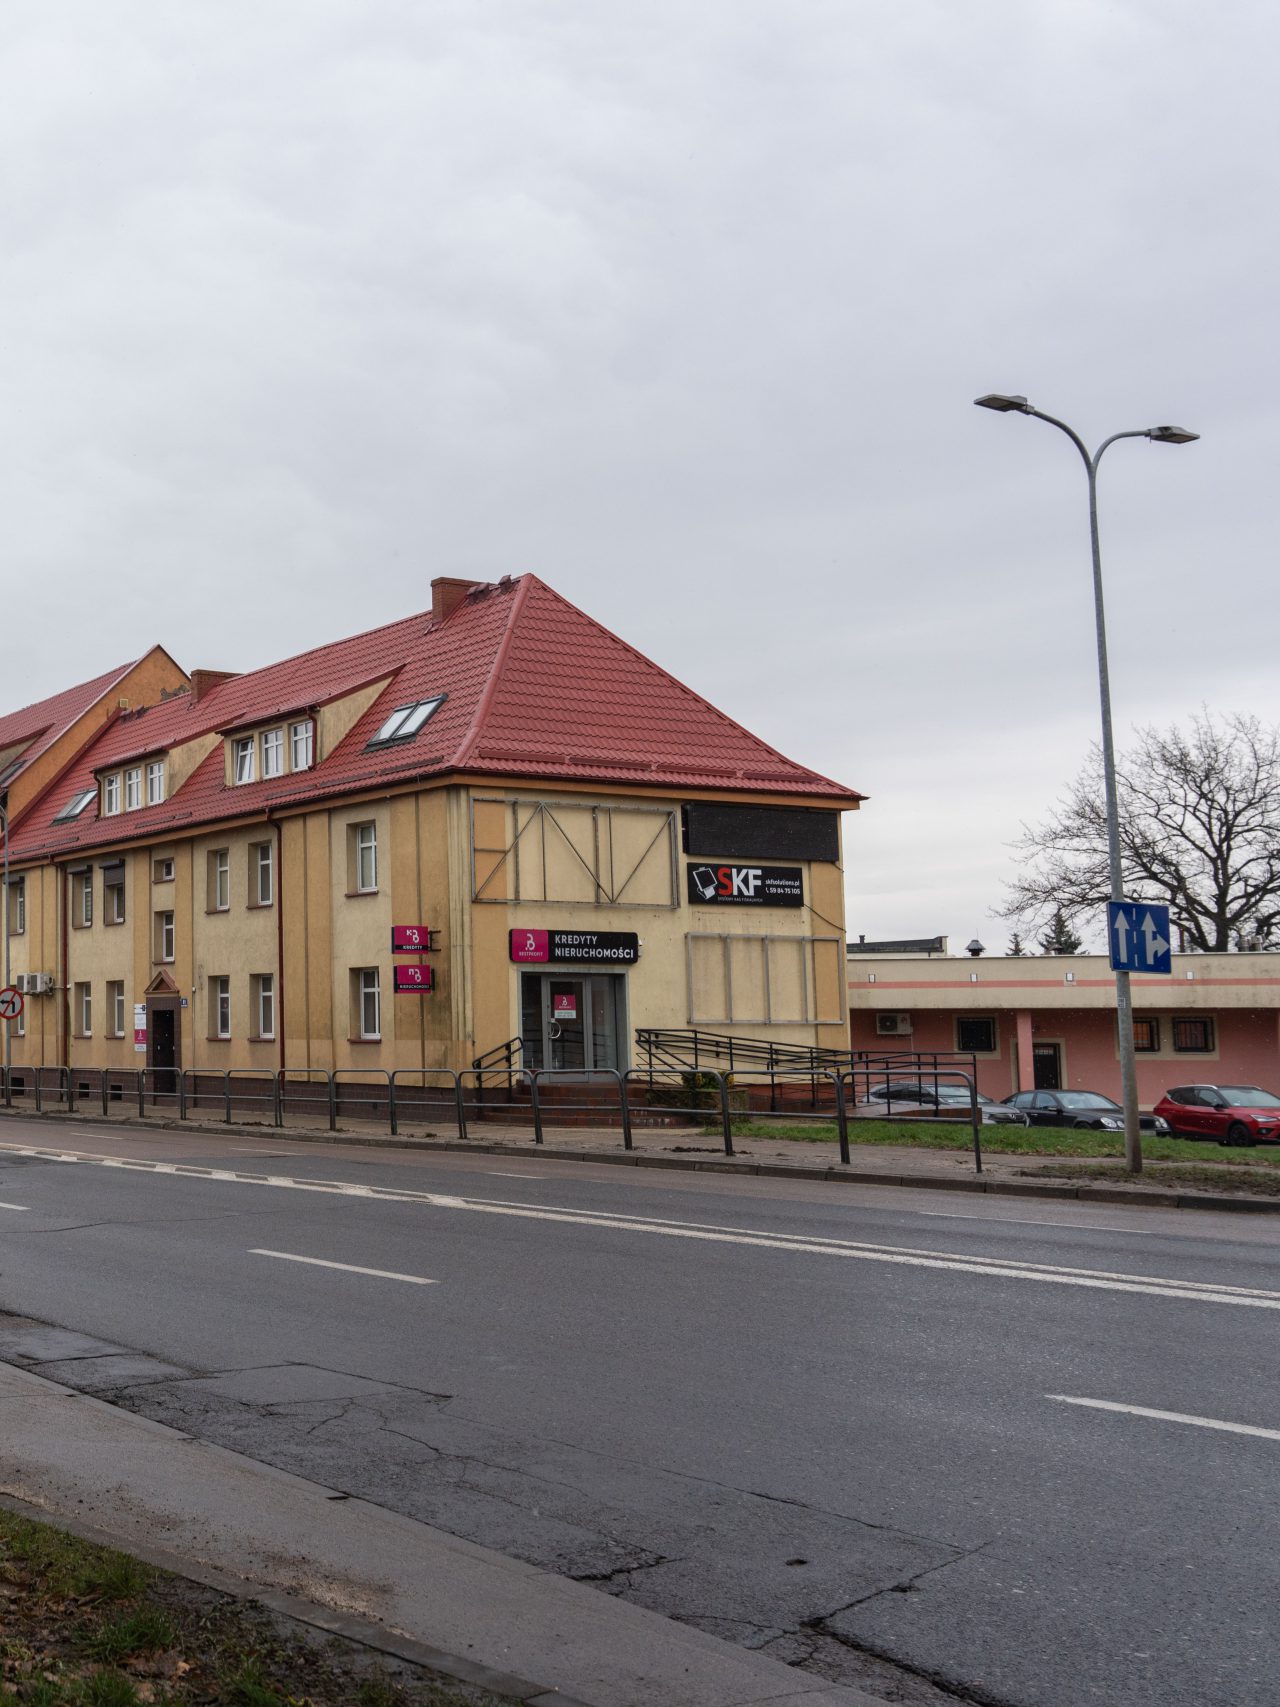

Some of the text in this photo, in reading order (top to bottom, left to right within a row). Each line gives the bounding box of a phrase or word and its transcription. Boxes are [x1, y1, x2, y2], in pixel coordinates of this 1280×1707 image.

[717, 867, 762, 896] SKF
[555, 935, 598, 945] KREDYTY
[555, 947, 634, 958] NIERUCHOMOŚCI
